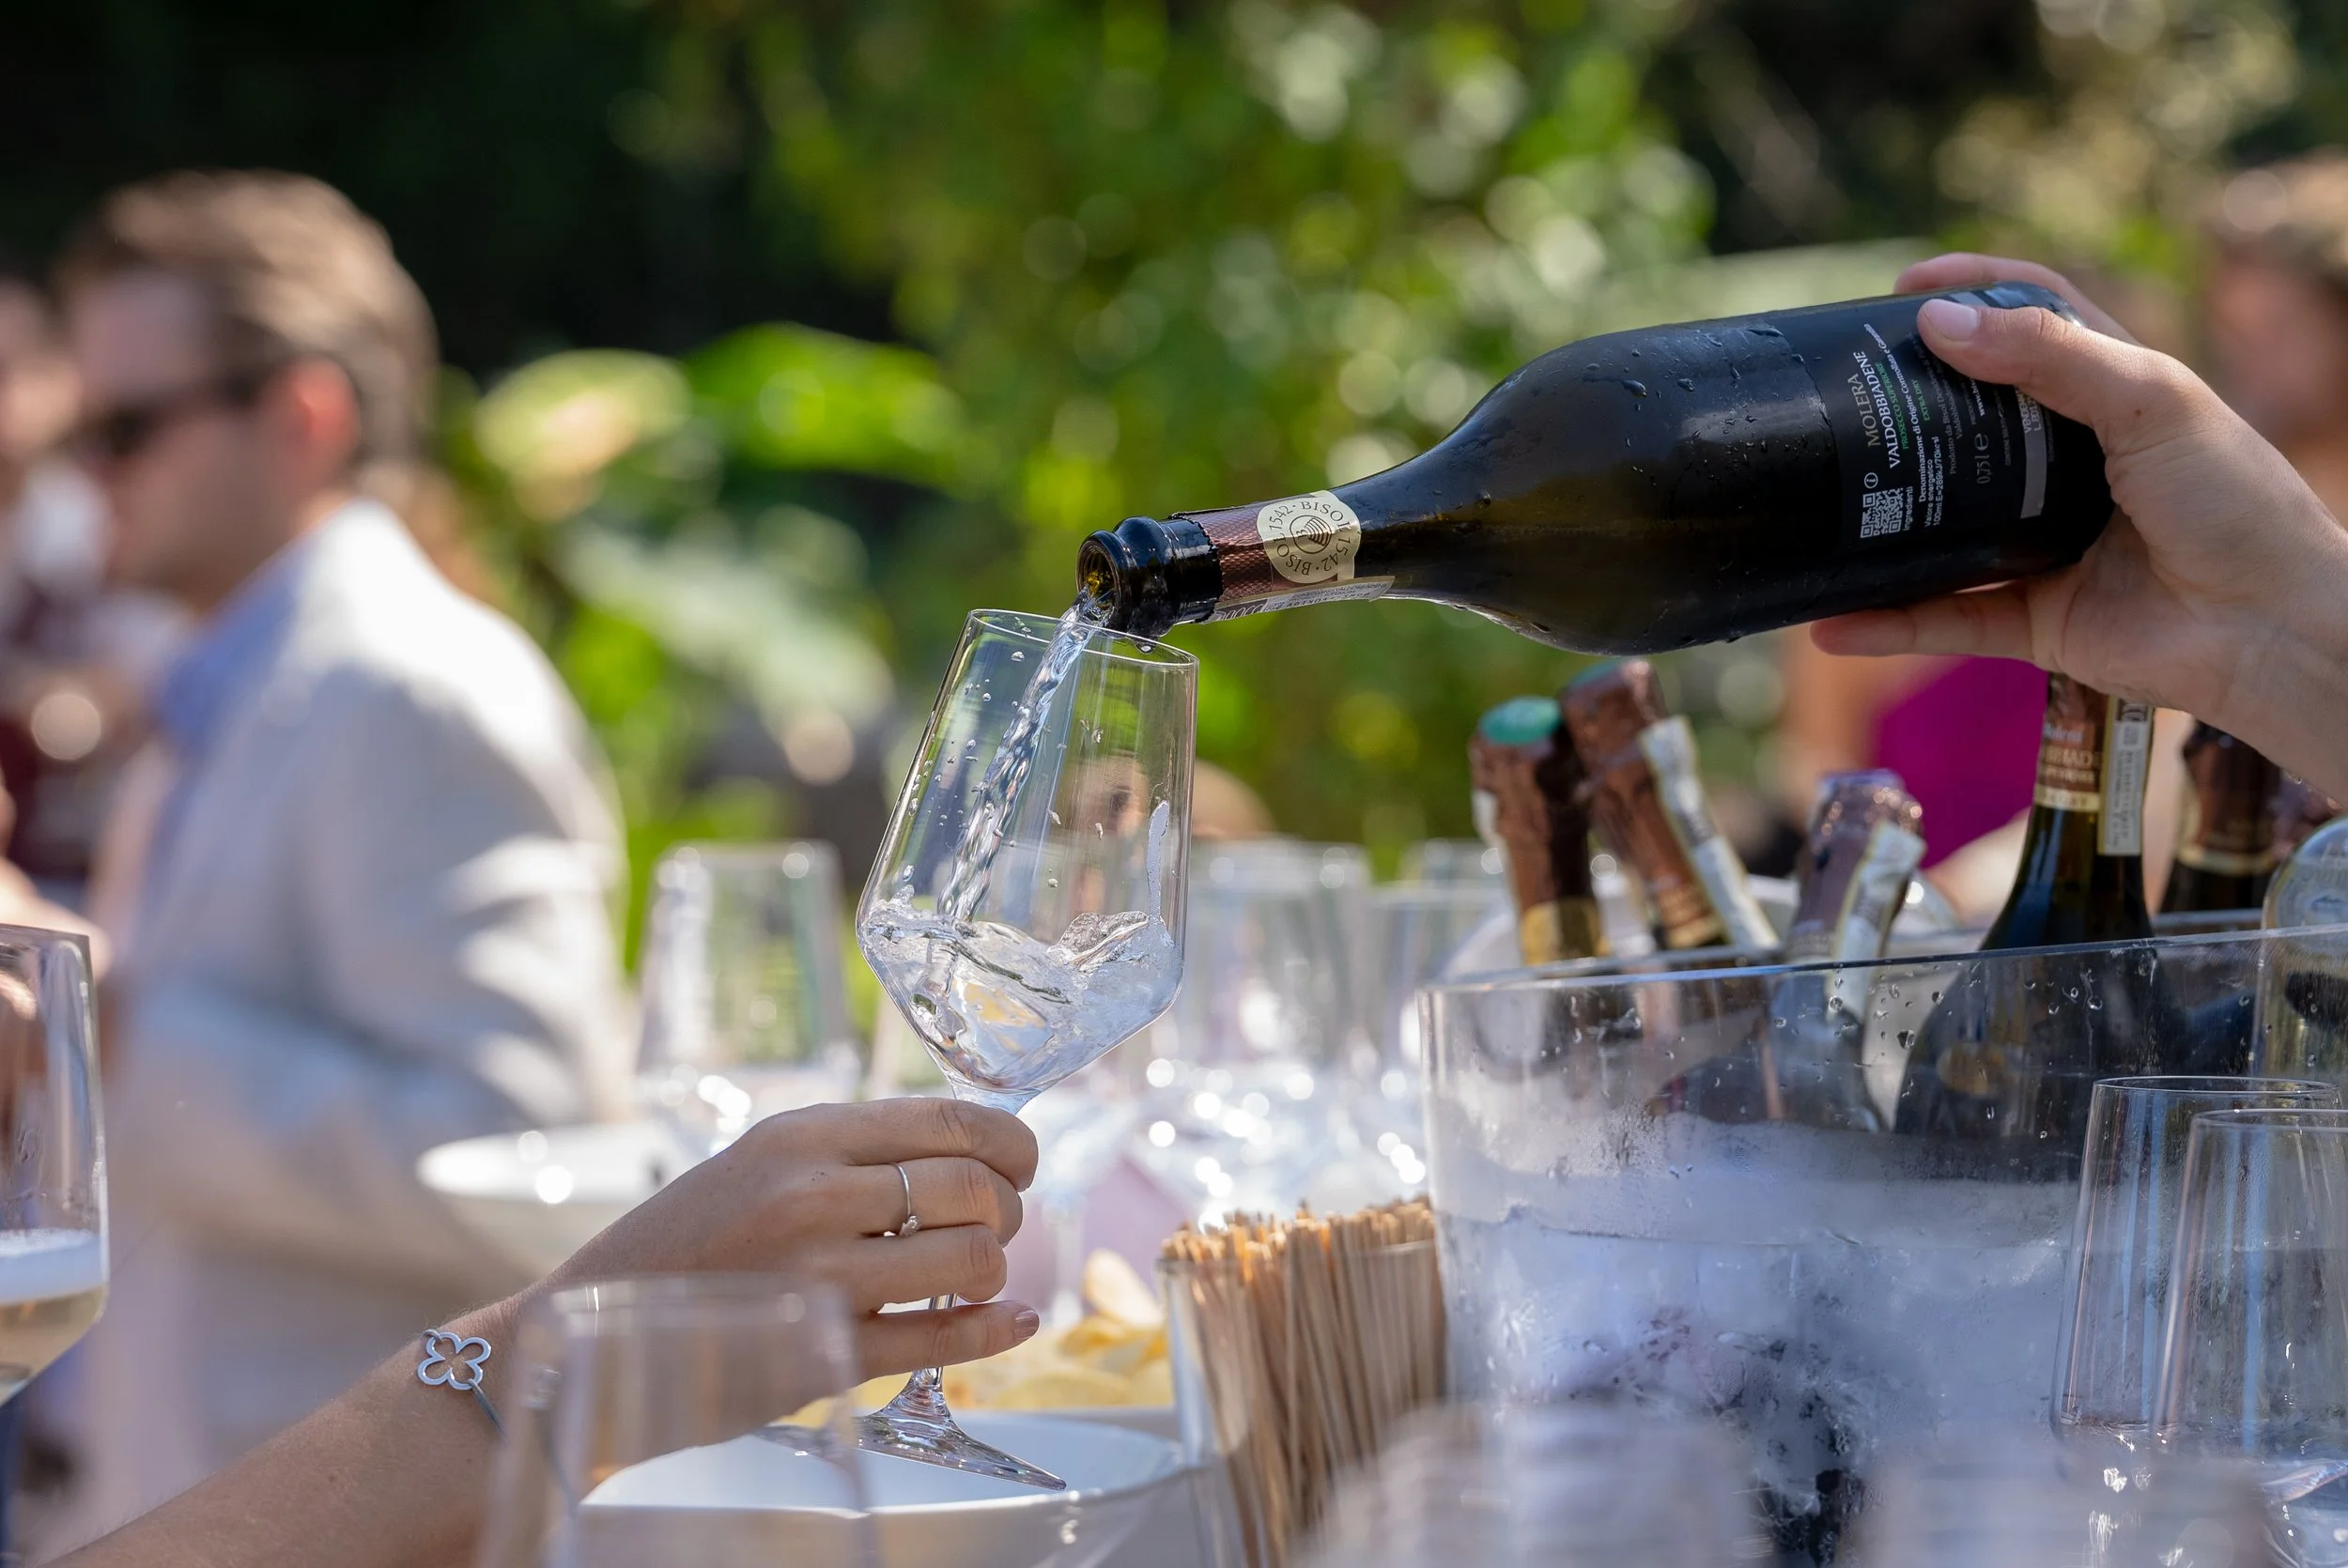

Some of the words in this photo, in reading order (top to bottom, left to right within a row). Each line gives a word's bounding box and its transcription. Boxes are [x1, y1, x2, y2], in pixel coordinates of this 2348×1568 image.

[1875, 361, 1898, 404] SUPERIORE
[1847, 374, 1881, 447] MOLERA
[1853, 351, 1901, 469] VALDOBBIADENE
[1905, 394, 1919, 424] Origine
[1917, 395, 1930, 421] EXTRA
[1939, 404, 1951, 424] Bisol
[1892, 405, 1909, 450] PROSECCO
[1912, 425, 1922, 434] di
[1944, 425, 1953, 436] da
[1916, 436, 1926, 502] Denominazione
[1947, 437, 1957, 475] Prodotto
[1927, 458, 1936, 501] energetico
[1269, 505, 1293, 531] 1542
[1301, 501, 1351, 531] BISOL
[1902, 486, 1913, 530] Ingredienti
[1924, 502, 1934, 528] Valore
[1274, 532, 1312, 576] BISOL
[1321, 536, 1352, 572] 1542
